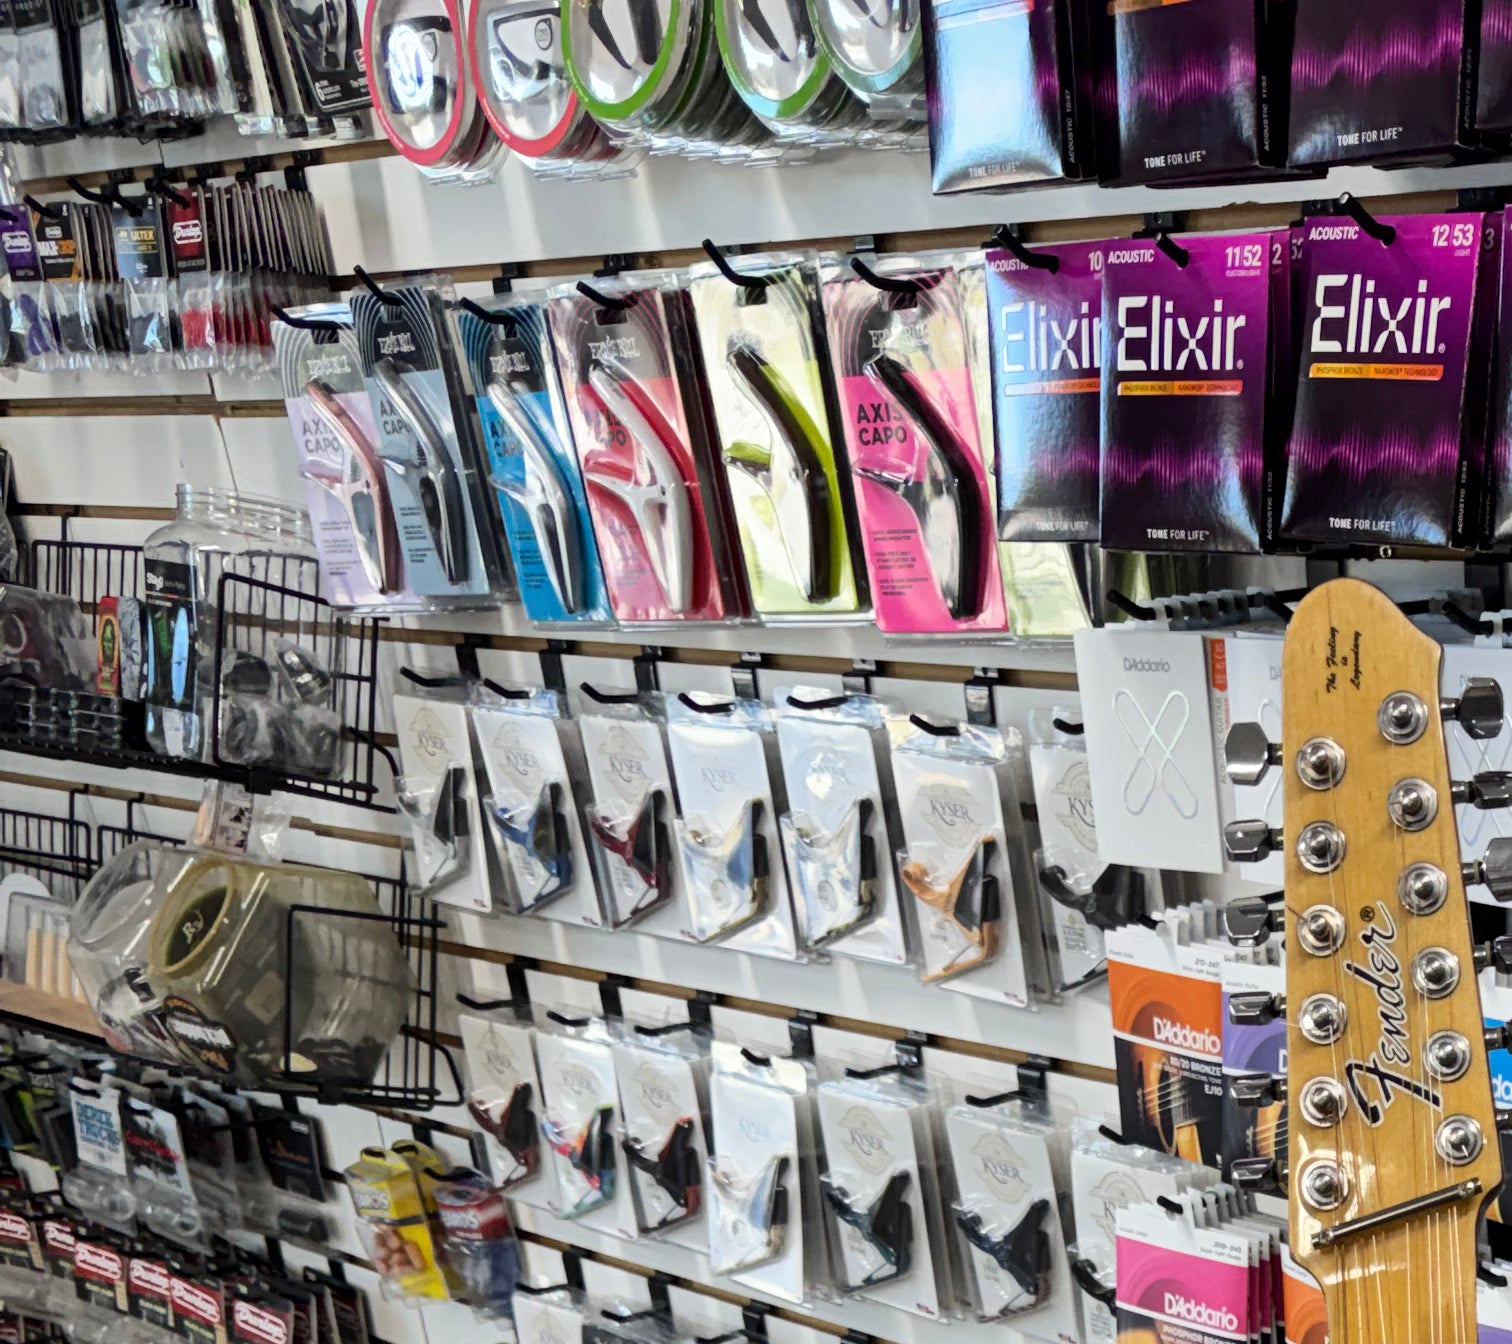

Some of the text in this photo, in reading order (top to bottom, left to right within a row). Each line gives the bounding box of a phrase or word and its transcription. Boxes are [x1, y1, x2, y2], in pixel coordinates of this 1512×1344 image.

[1309, 226, 1358, 241] ACOUSTIC
[1108, 249, 1154, 264] ACOUSTIC
[858, 427, 907, 446] CAPO
[927, 796, 973, 824] KYSER
[1345, 900, 1444, 1129] Fender
[1153, 1017, 1221, 1053] D'Addario
[850, 1128, 886, 1156] KYSER
[983, 1158, 1023, 1184] KYSER
[1164, 1292, 1238, 1331] D'Addario
